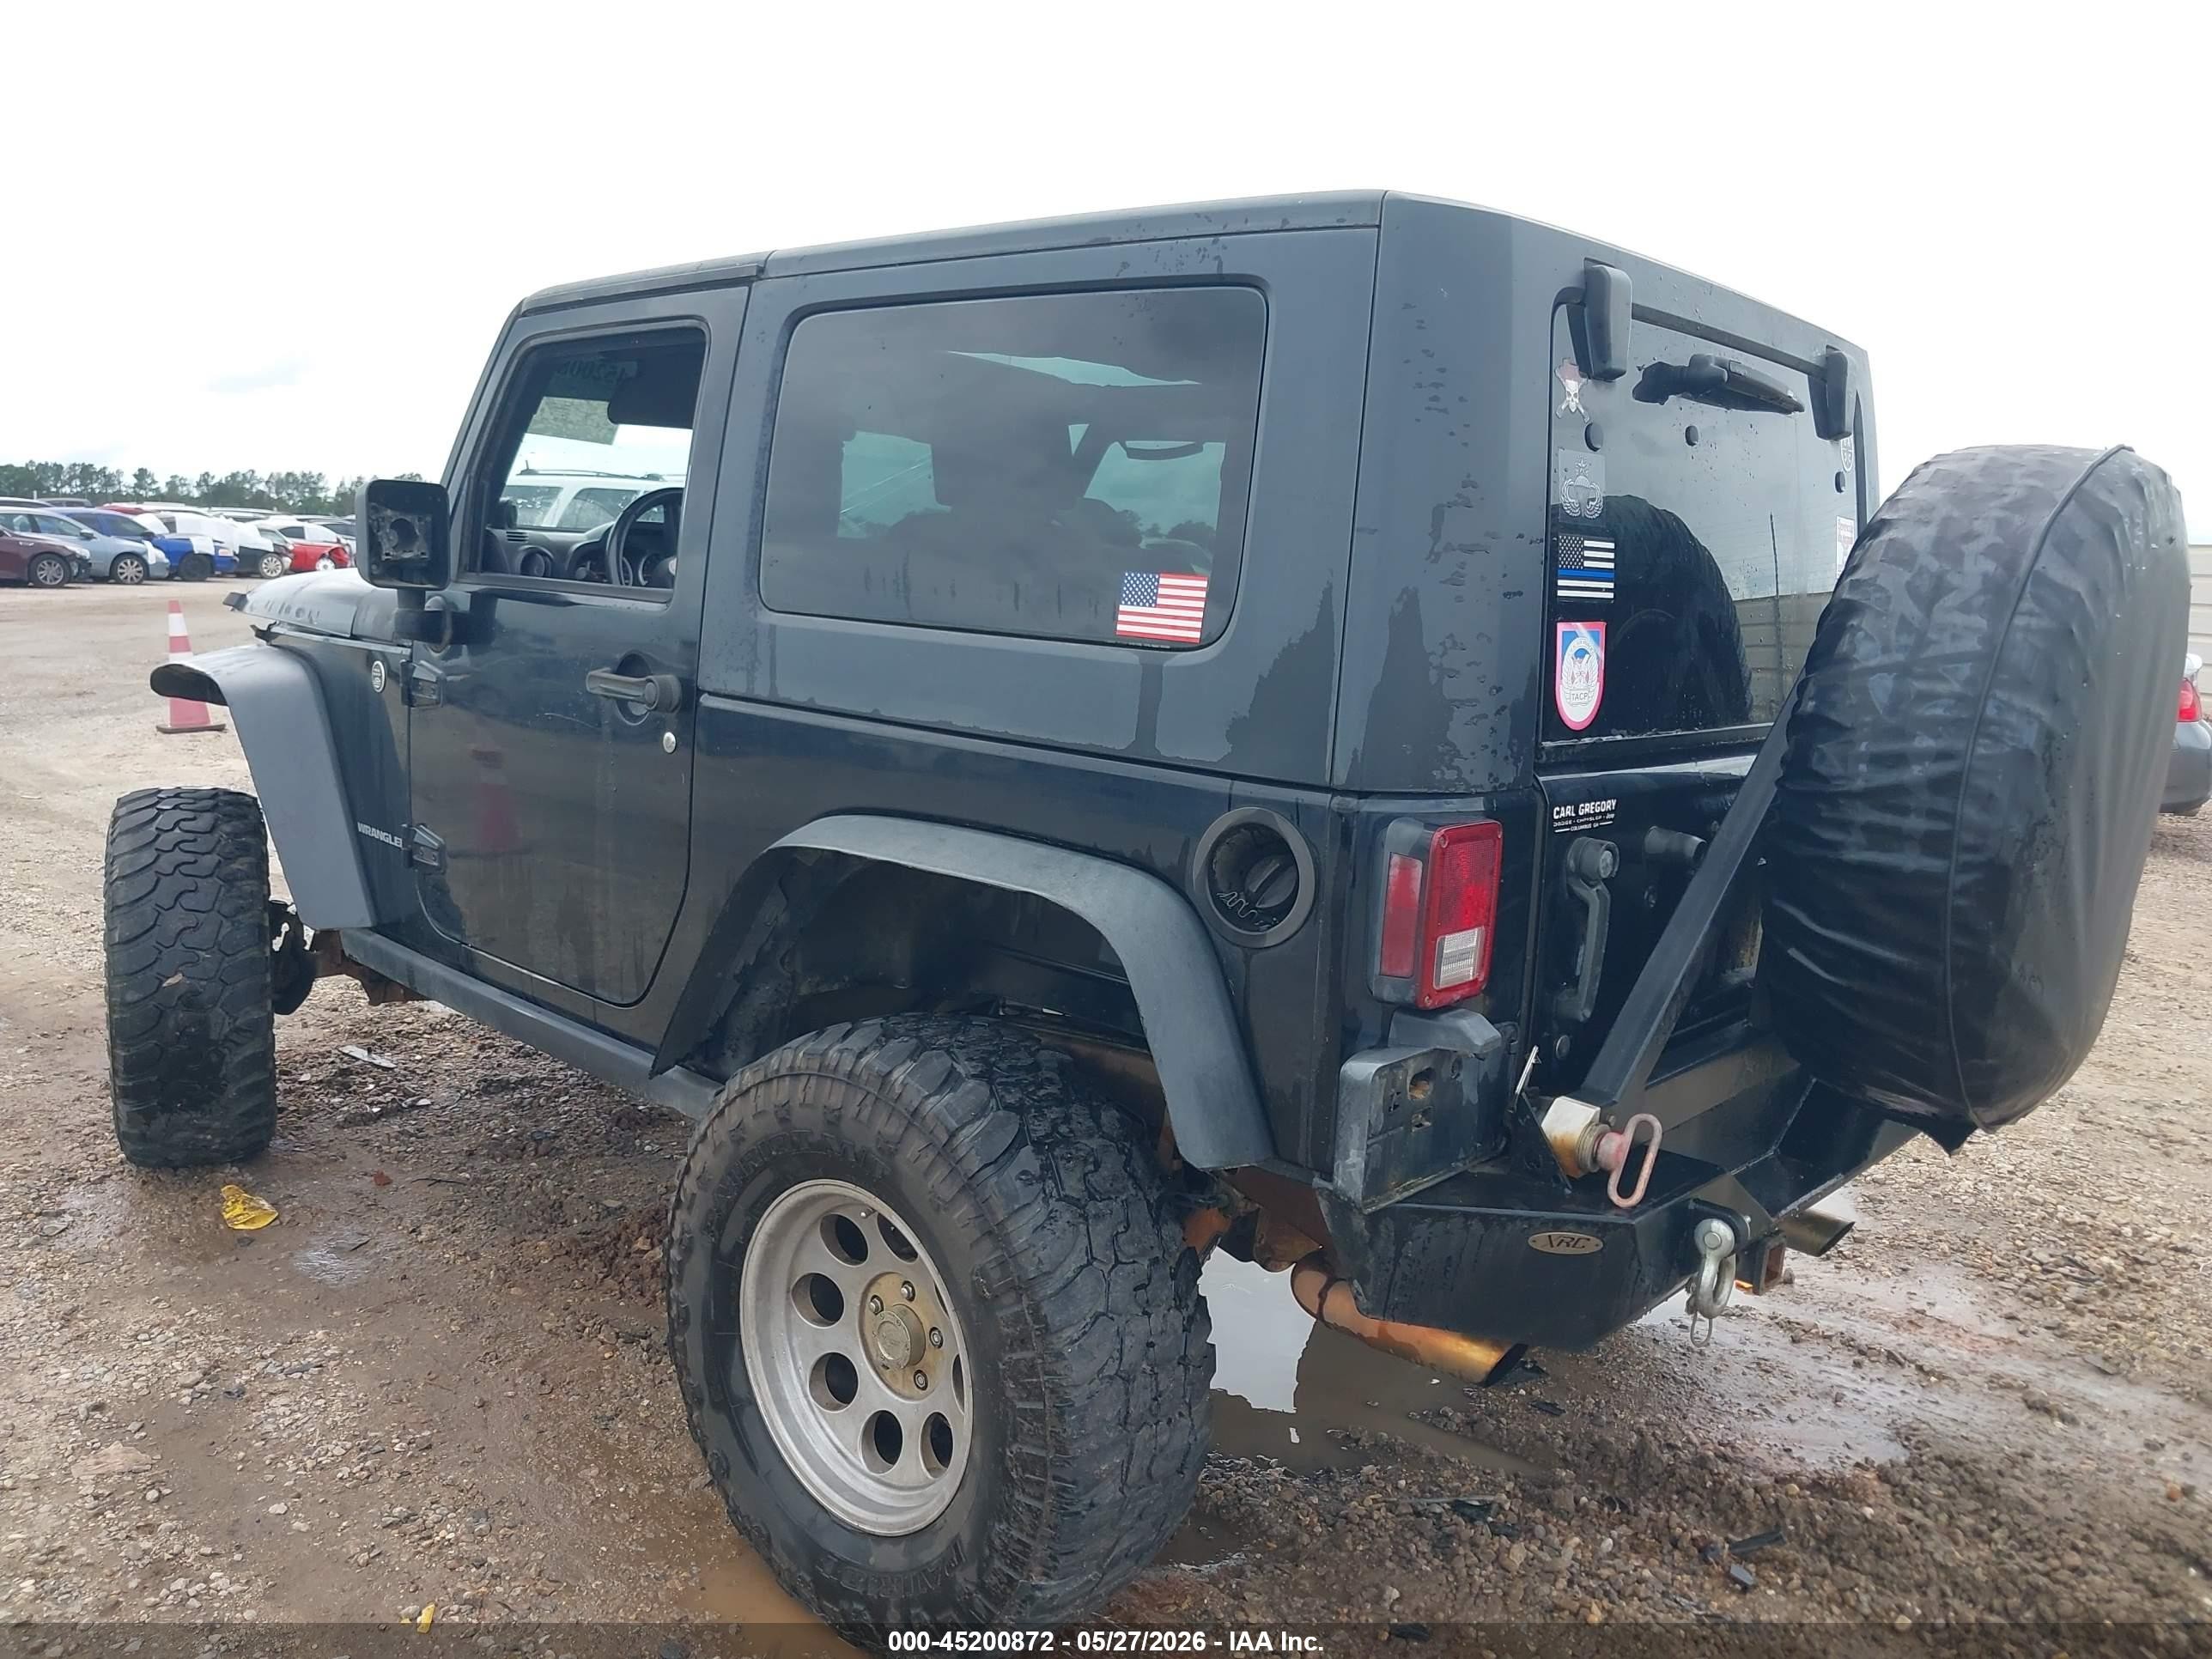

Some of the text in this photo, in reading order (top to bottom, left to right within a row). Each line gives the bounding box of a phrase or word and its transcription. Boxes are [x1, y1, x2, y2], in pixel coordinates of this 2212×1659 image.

[1571, 693, 1588, 702] TACP
[1553, 799, 1617, 819] CARL GREGORY
[1577, 815, 1602, 823] CHRYSLER
